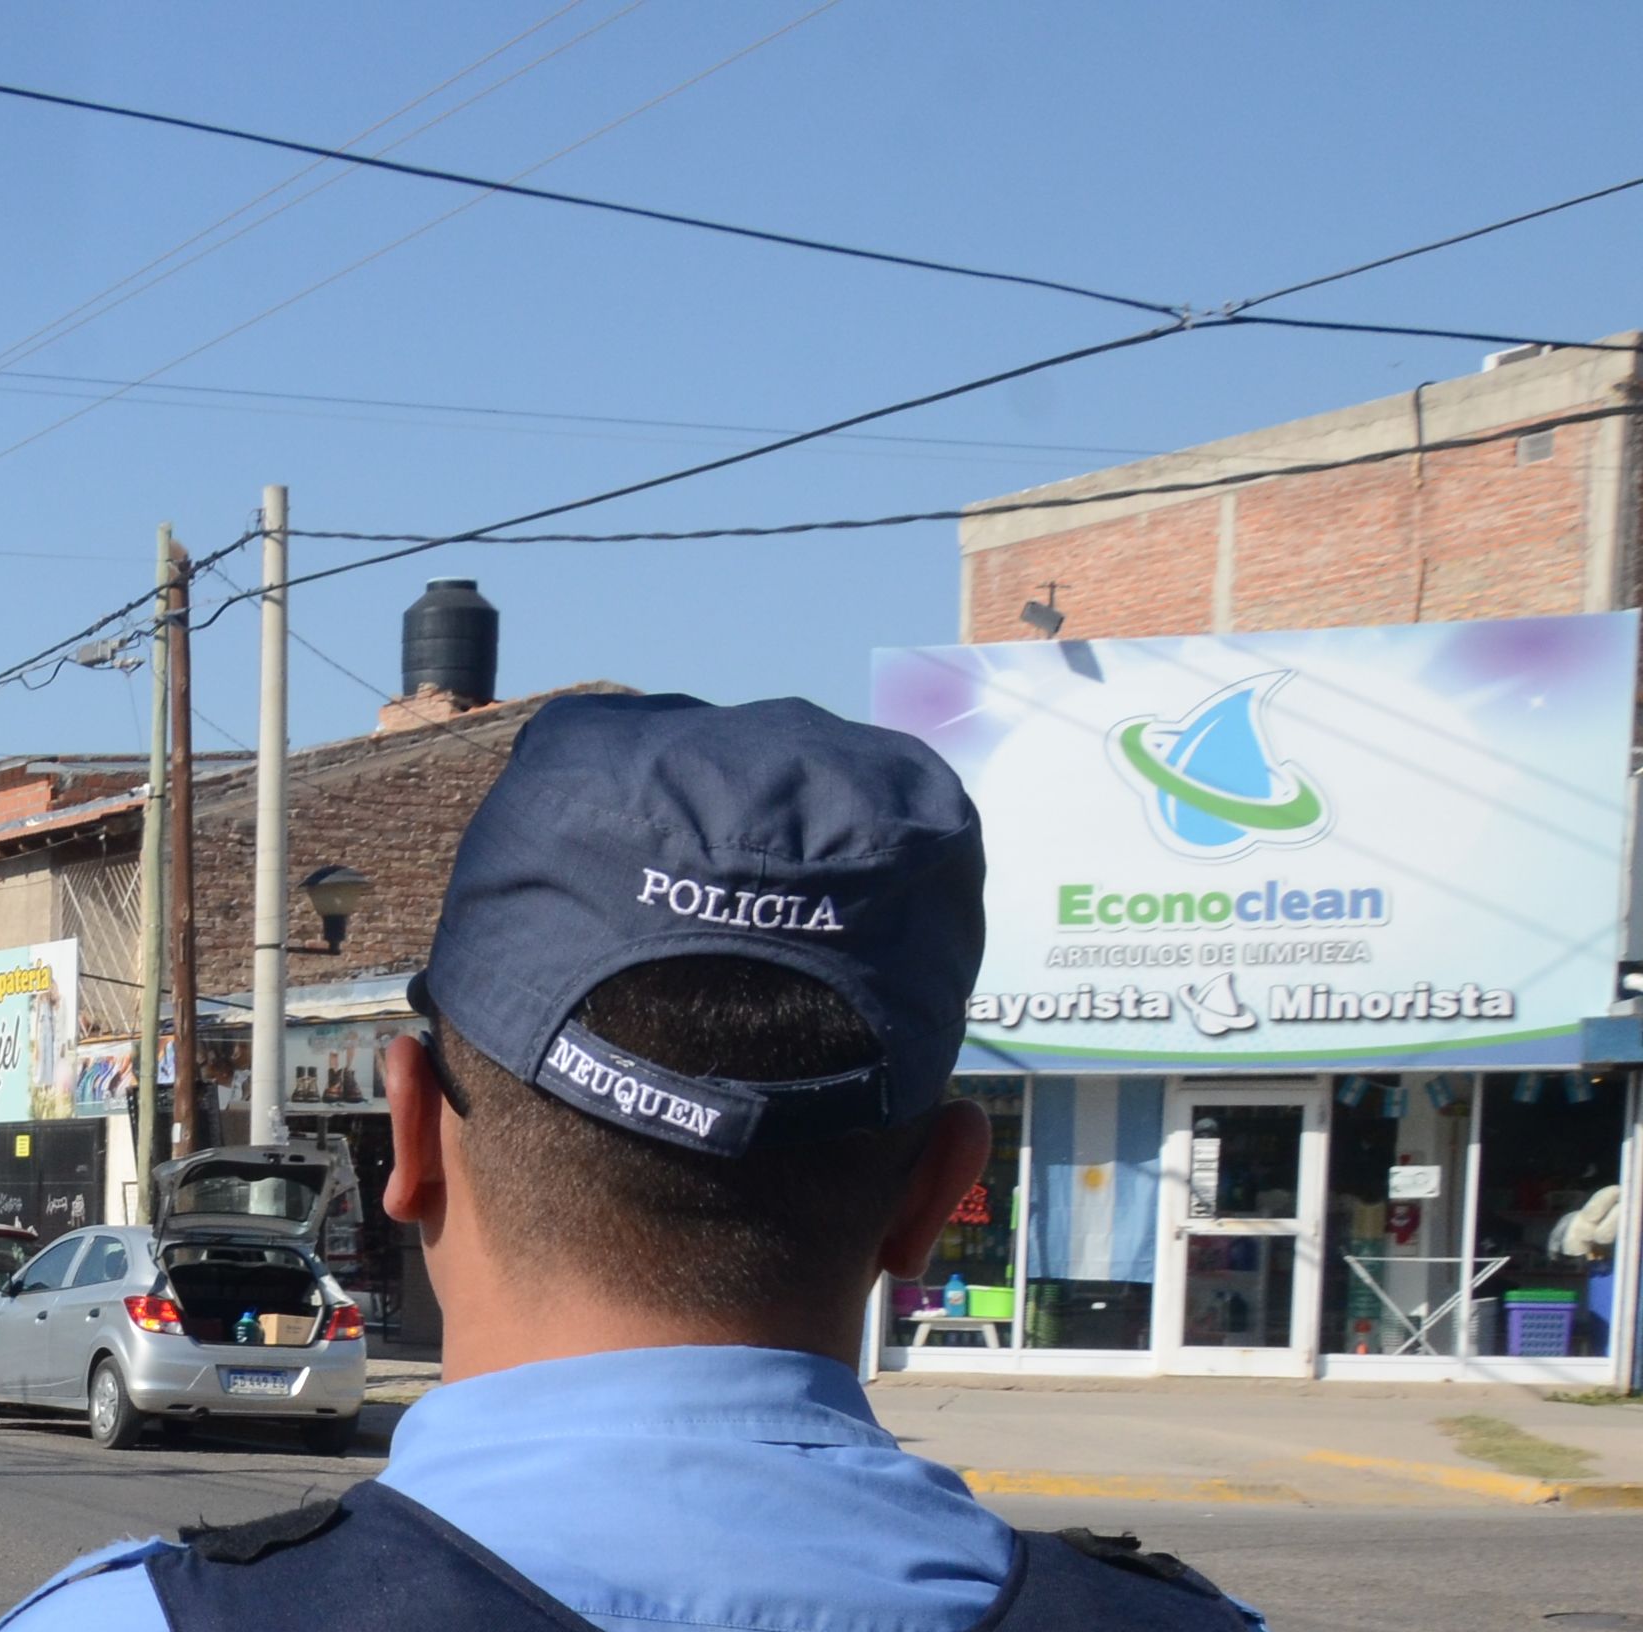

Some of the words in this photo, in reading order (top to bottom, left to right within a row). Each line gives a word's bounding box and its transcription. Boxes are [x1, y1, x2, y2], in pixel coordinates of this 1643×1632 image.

[636, 868, 844, 931] POLICIA
[1057, 880, 1387, 928] Econoclean
[1047, 944, 1192, 968] ARTICULOS
[1200, 943, 1237, 966] DE
[1242, 941, 1371, 965] LIMPIEZA
[965, 984, 1171, 1028] ayorista
[1269, 981, 1515, 1021] Minorista
[546, 1036, 721, 1138] NEUQUEN
